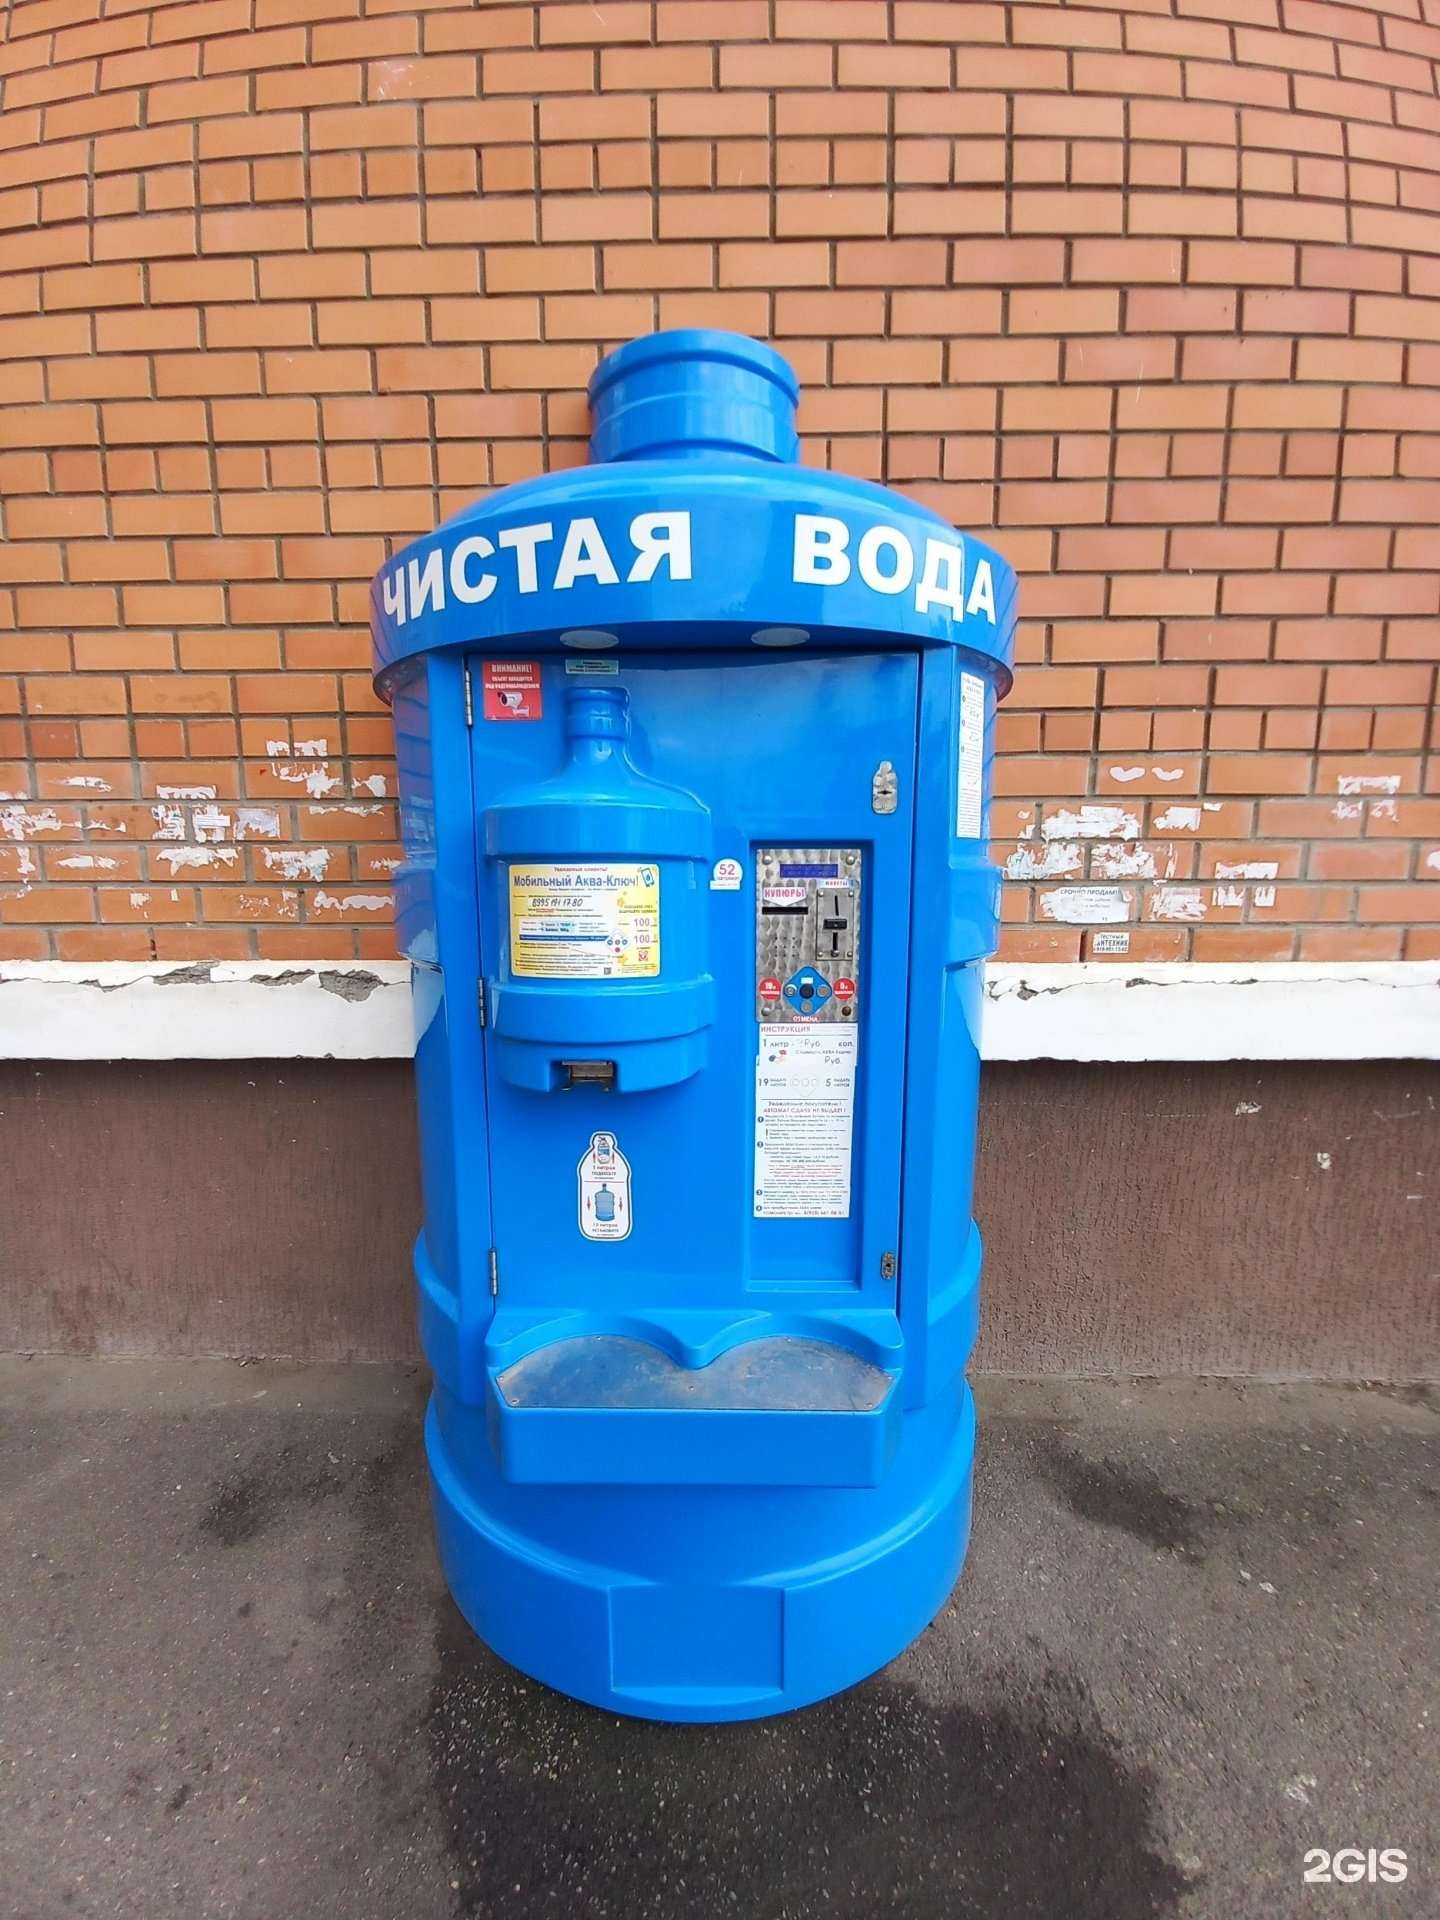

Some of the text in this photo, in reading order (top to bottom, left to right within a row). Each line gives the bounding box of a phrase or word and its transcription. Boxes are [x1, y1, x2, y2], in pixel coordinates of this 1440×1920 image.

[382, 511, 998, 626] ЧИСТАЯ ВОДА
[719, 864, 735, 876] 52
[514, 875, 639, 888] Мобильный Аква-Ключ!
[764, 888, 806, 899] КУПЮРЫ
[634, 917, 650, 927] 100
[634, 934, 650, 944] 100
[761, 1025, 811, 1033] ИНСТРУКЦИЯ
[825, 1078, 832, 1087] 5
